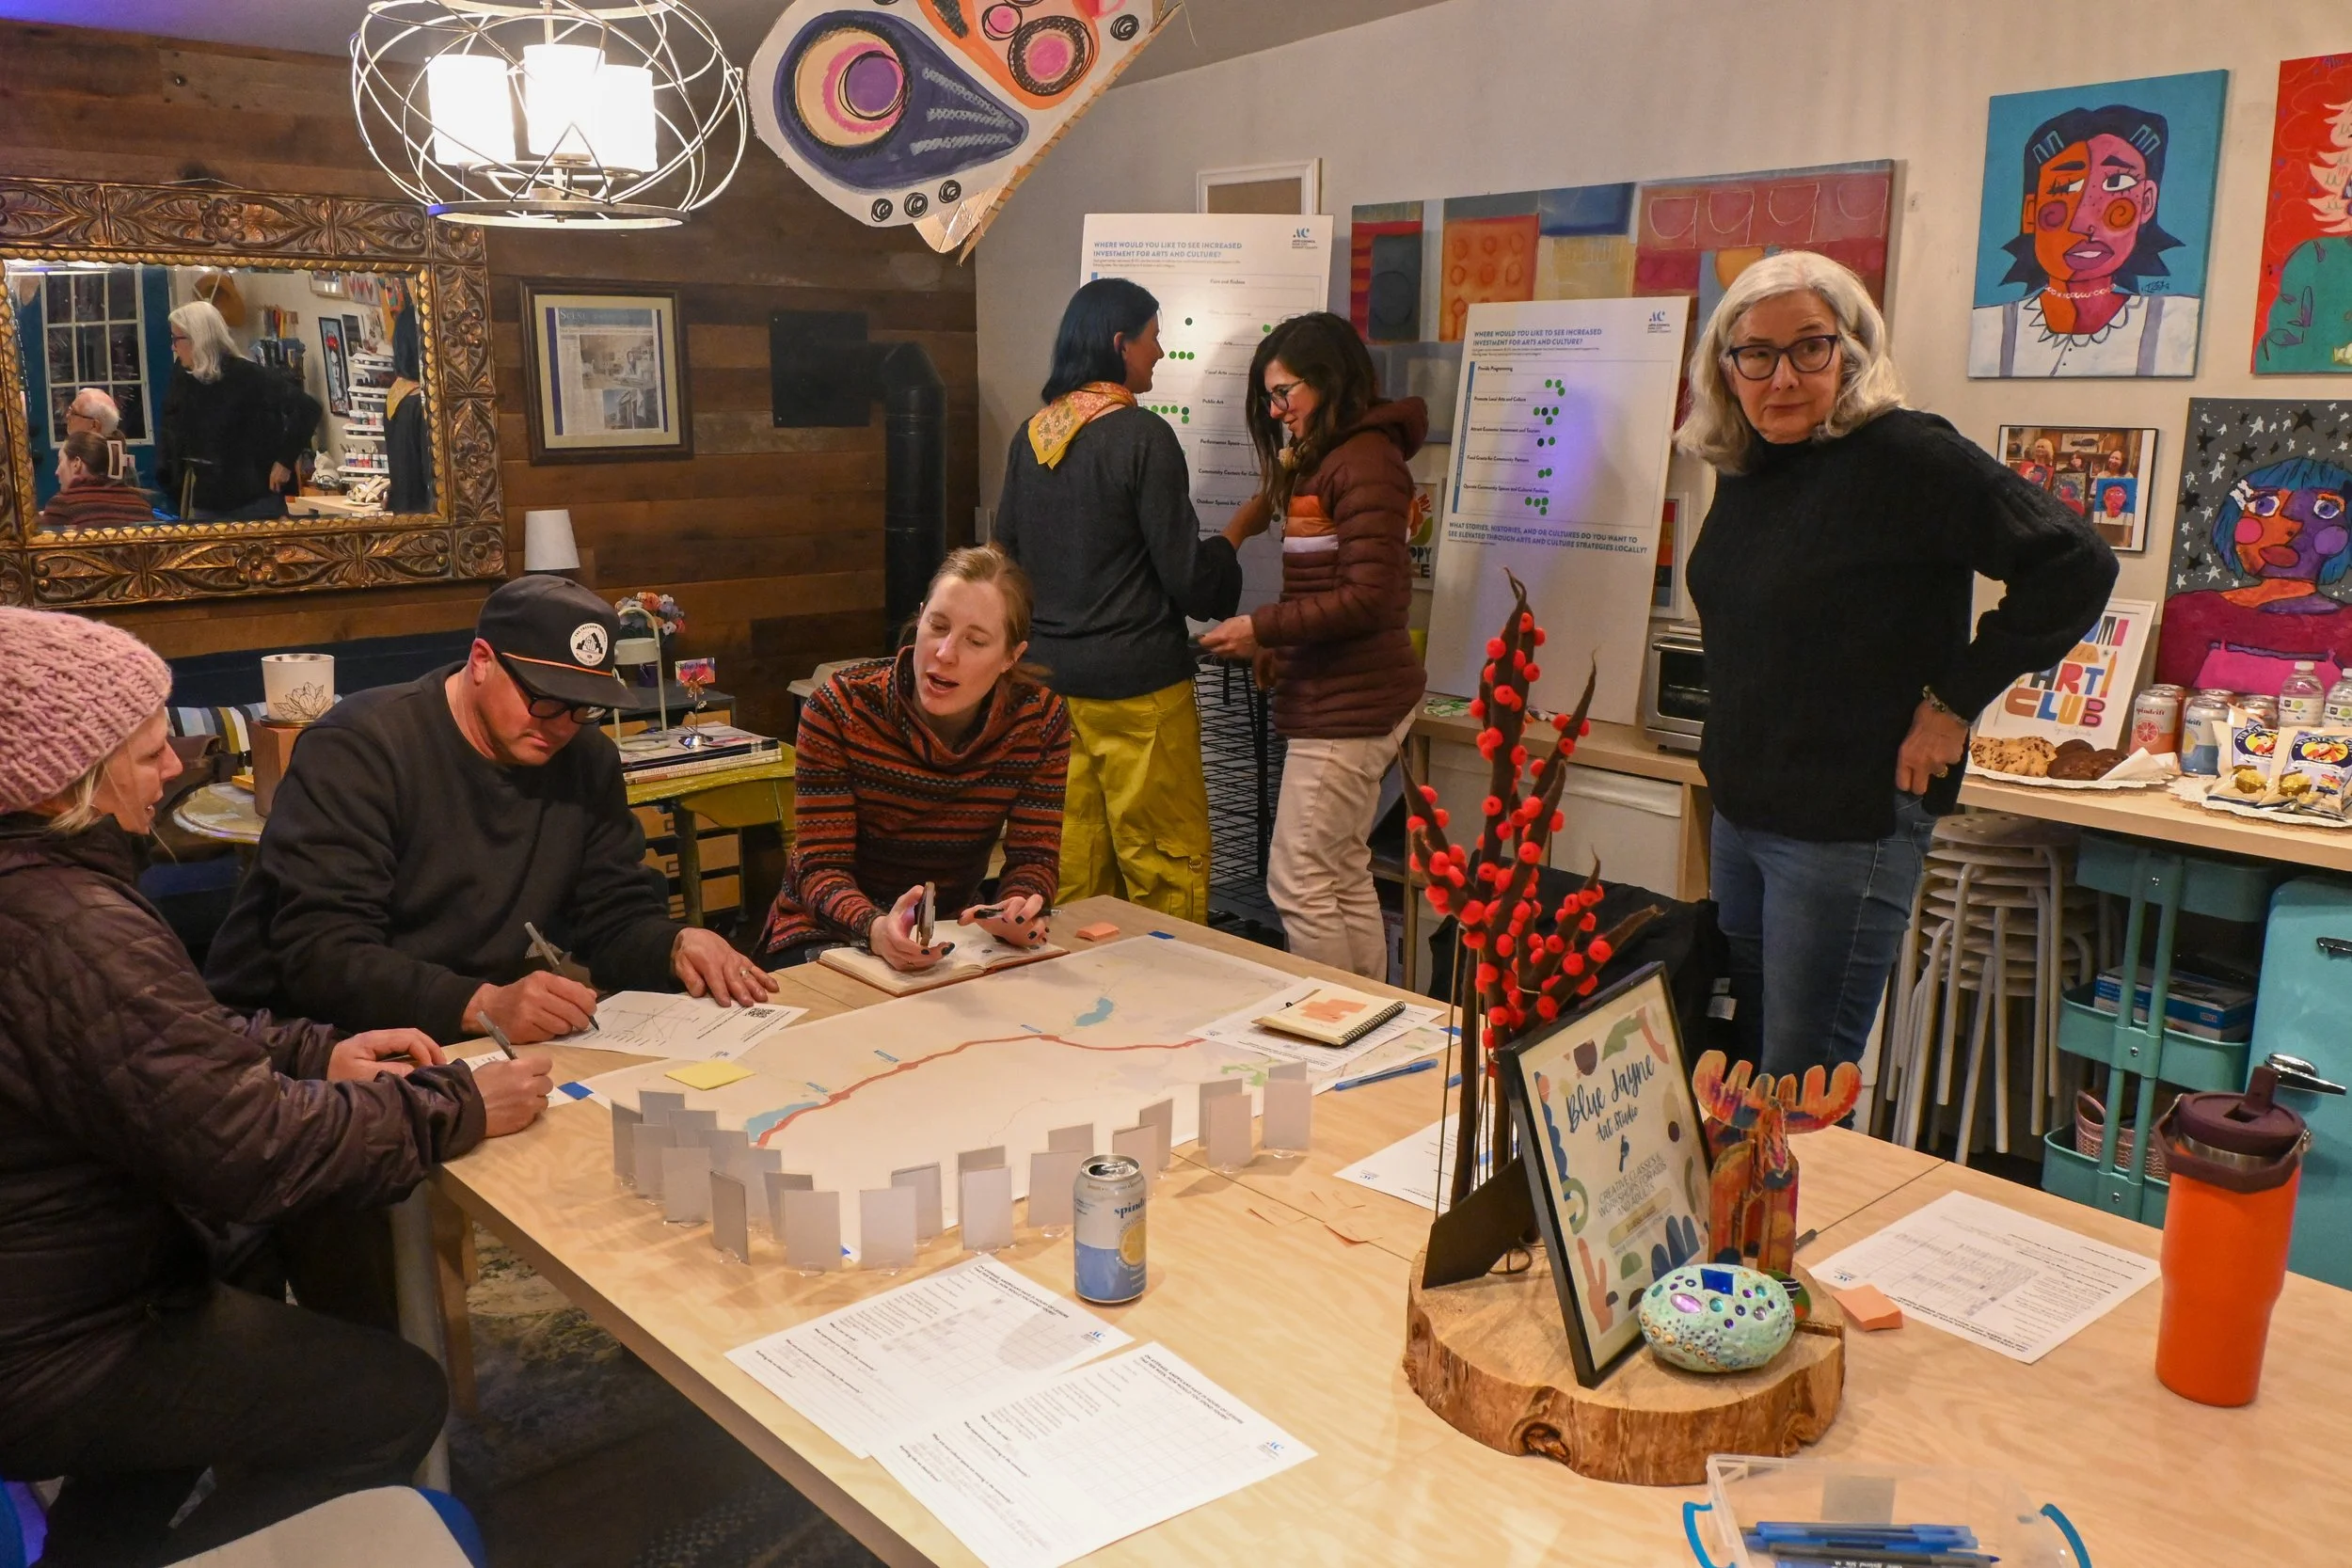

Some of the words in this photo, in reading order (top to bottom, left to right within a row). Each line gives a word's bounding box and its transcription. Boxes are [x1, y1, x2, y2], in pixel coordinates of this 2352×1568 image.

[1459, 531, 1486, 540] ELEVATED
[1486, 534, 1516, 543] THROUGH
[1547, 539, 1575, 547] CULTURE
[1576, 541, 1613, 551] STRATEGIES
[1614, 545, 1647, 554] LOCALLY?
[1465, 523, 1489, 531] STORIES,
[1491, 525, 1522, 534] HISTORIES,
[1549, 530, 1581, 539] CULTURES
[2005, 688, 2106, 727] CLUB
[1565, 1084, 1605, 1132] Blue
[1612, 1054, 1654, 1102] Jayne
[1597, 1117, 1613, 1143] Art
[1614, 1104, 1638, 1131] Studio
[1598, 1182, 1638, 1217] WORKSHOPS
[1639, 1170, 1652, 1186] FOR
[1652, 1161, 1667, 1177] KIDS
[1599, 1175, 1629, 1204] CREATIVE
[1629, 1157, 1654, 1180] CLASSES
[1618, 1200, 1631, 1215] AND
[1631, 1183, 1655, 1204] ADULTS
